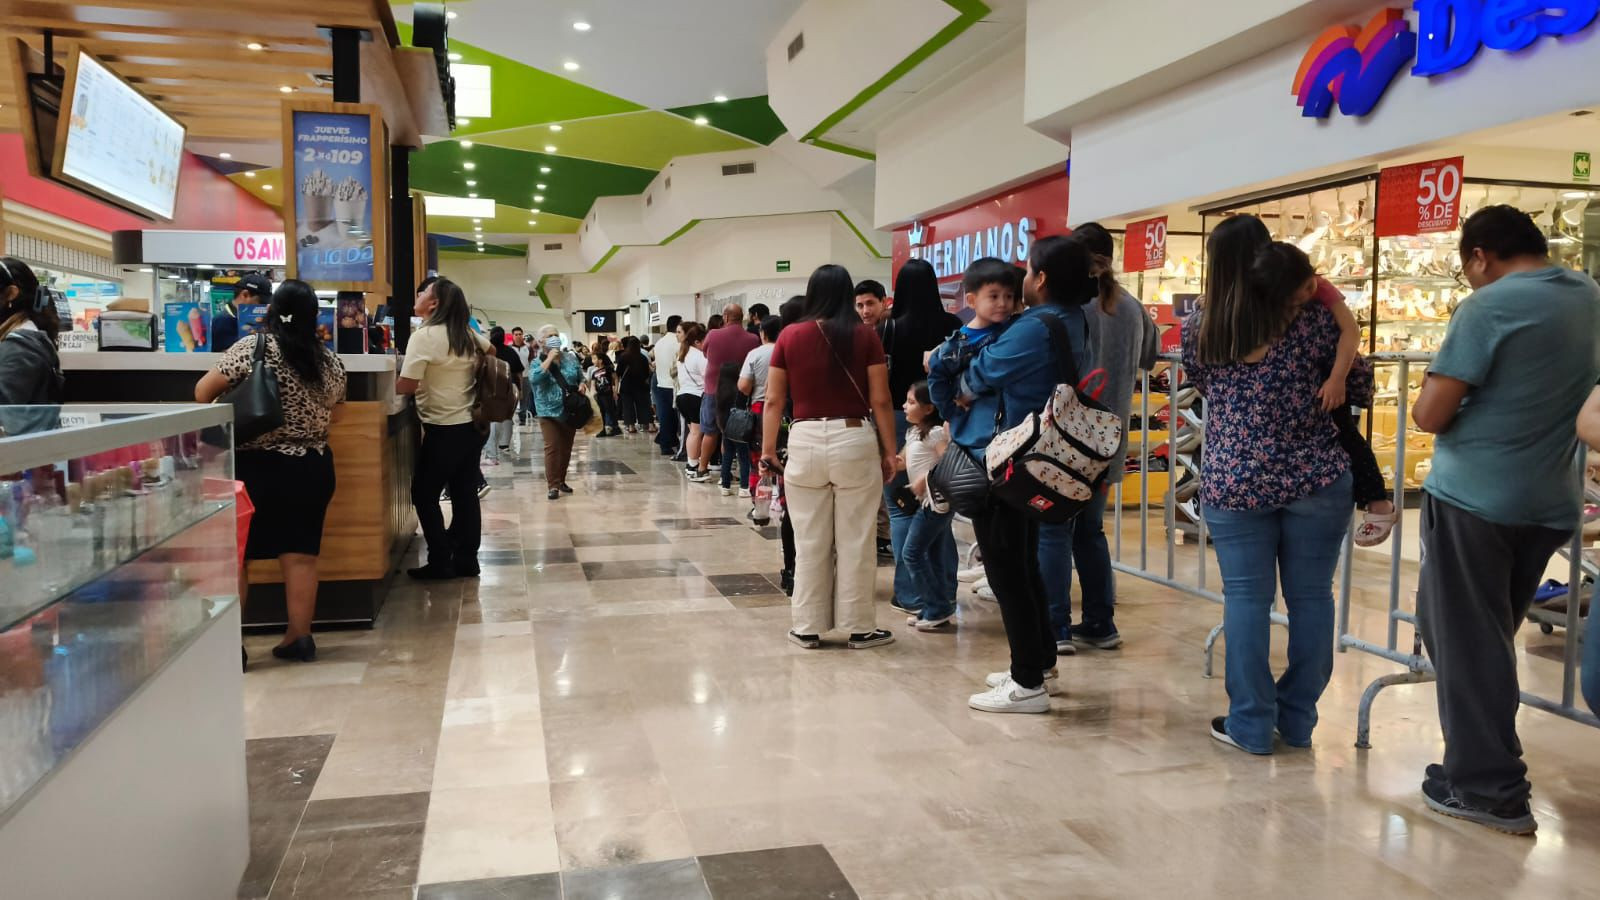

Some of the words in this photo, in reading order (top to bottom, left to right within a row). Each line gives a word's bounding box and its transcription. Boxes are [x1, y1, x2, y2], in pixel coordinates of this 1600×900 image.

[314, 126, 350, 134] JUEVES
[304, 147, 315, 162] 2
[1417, 164, 1459, 205] 50
[1434, 203, 1453, 219] DE
[1418, 219, 1452, 228] DESCUENTO
[1144, 221, 1166, 249] 50
[234, 237, 284, 260] OSAM
[923, 217, 1030, 278] HERMANOS
[1153, 247, 1163, 259] DE
